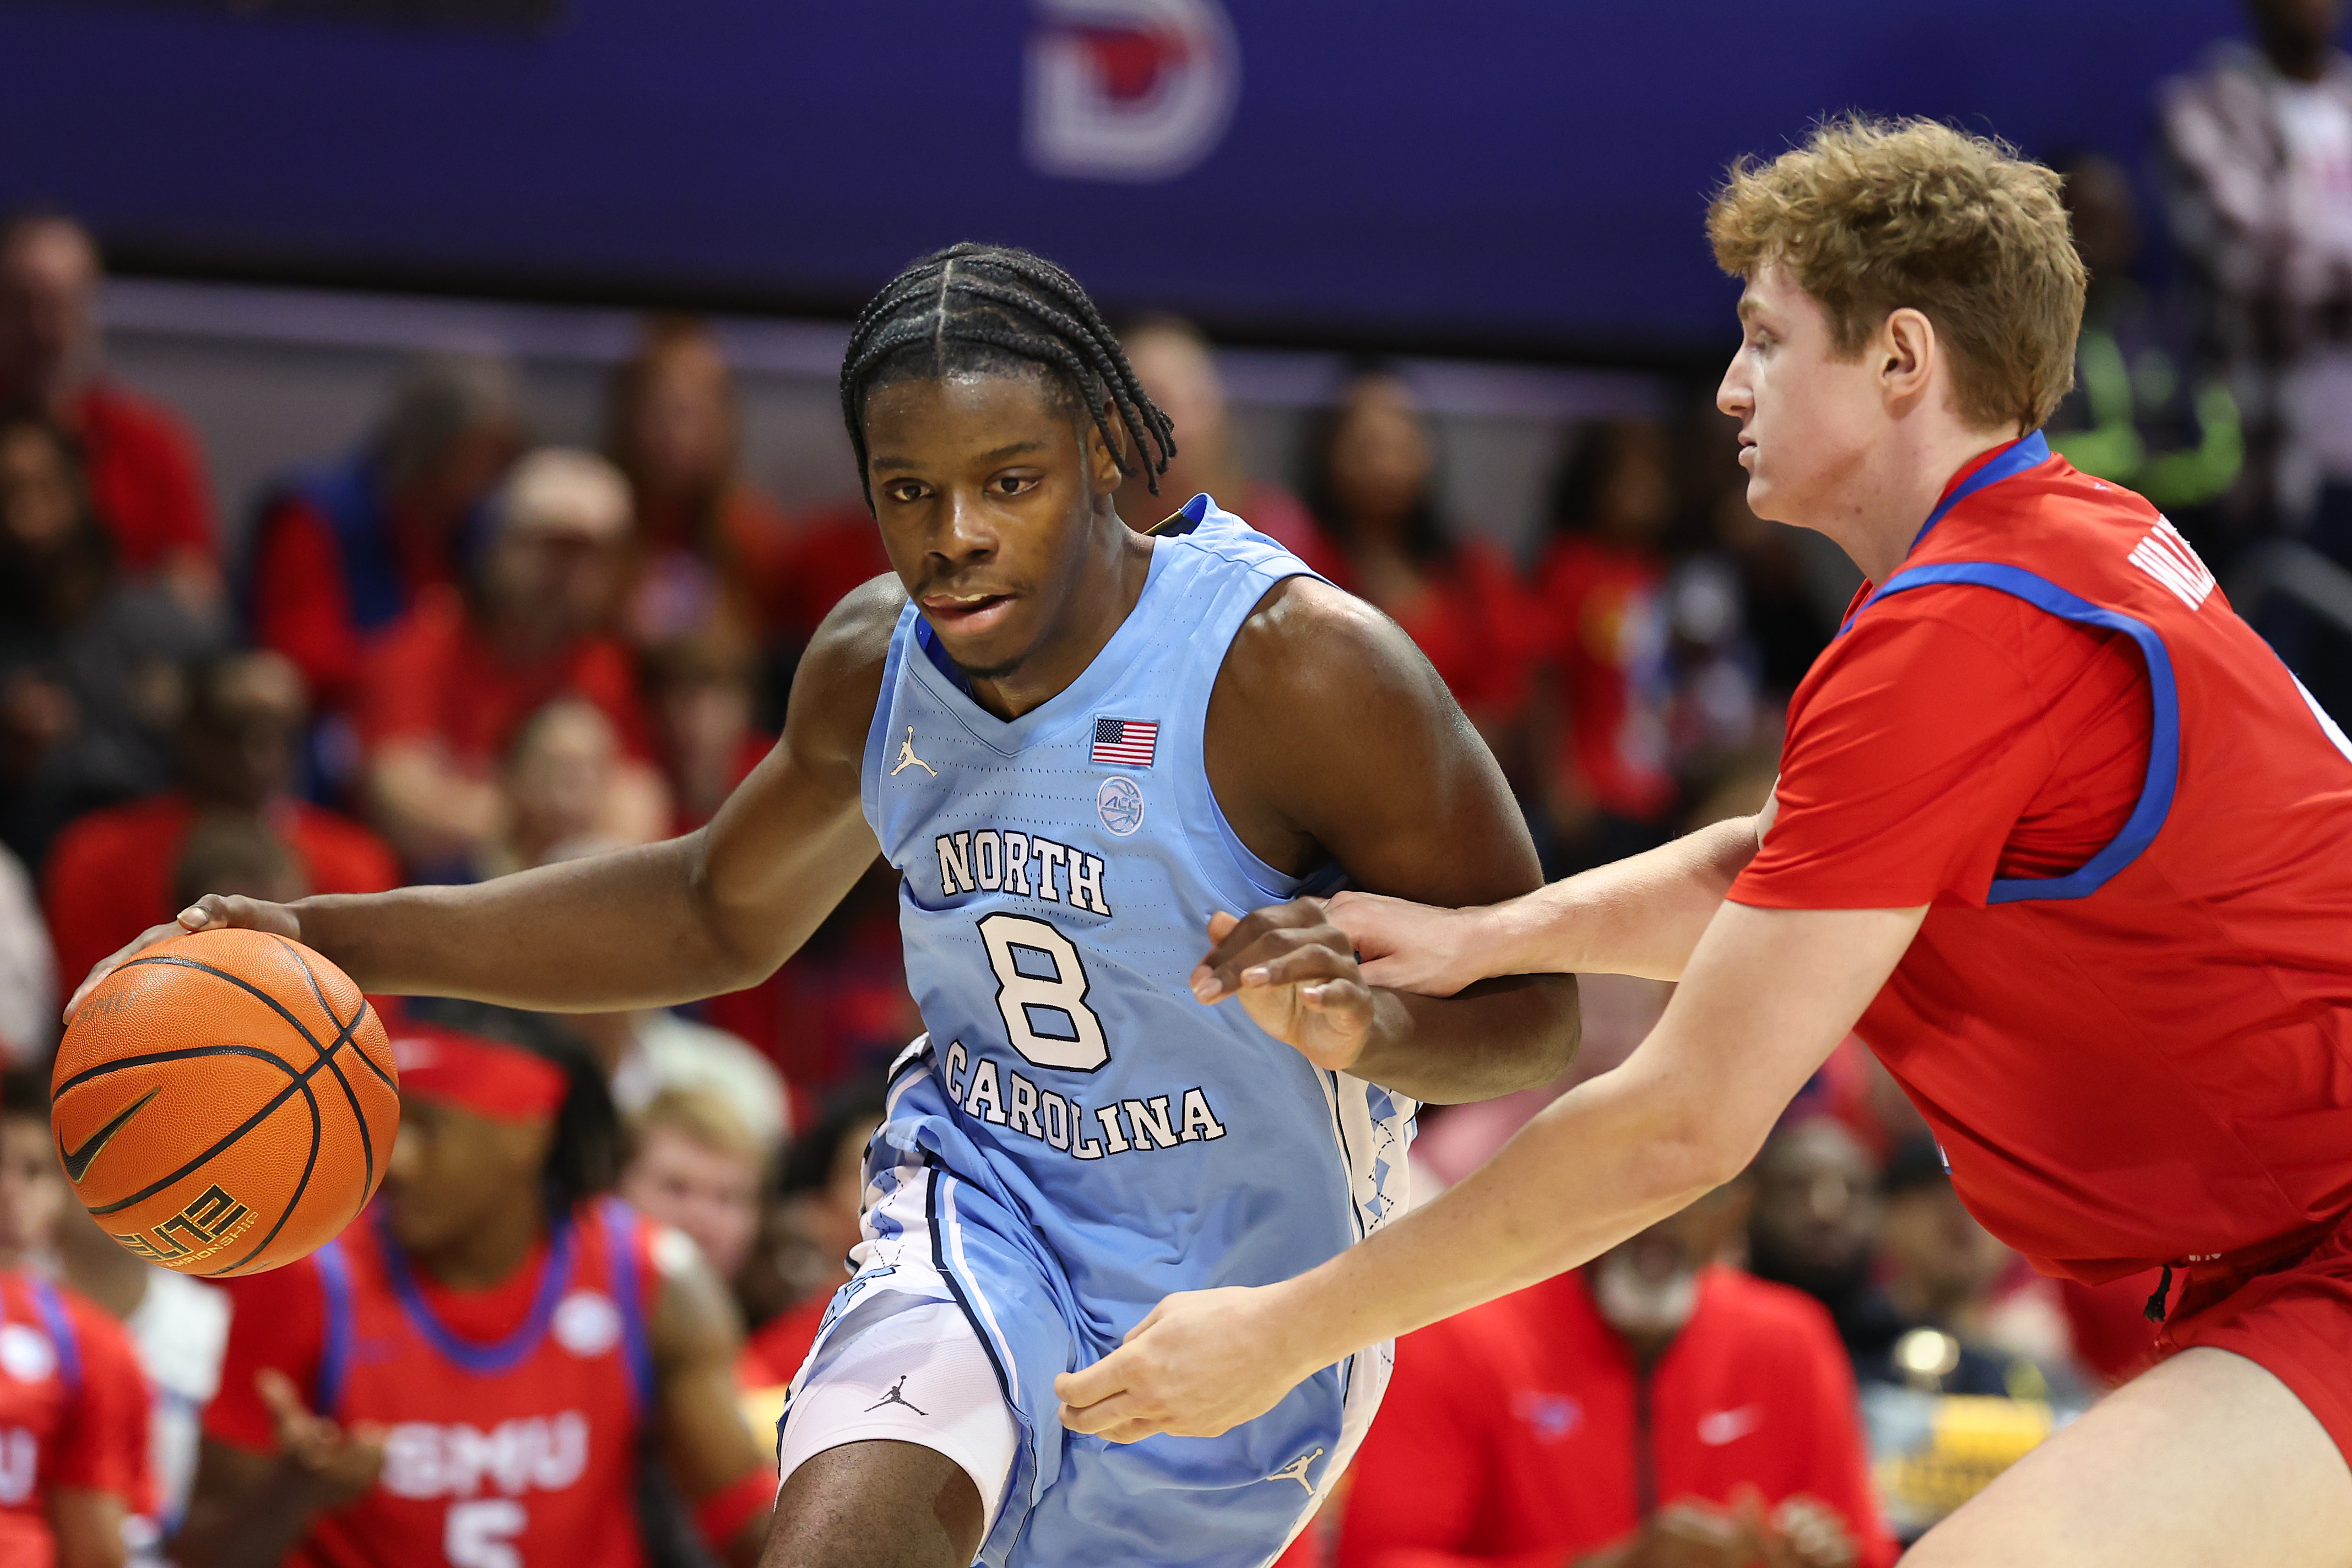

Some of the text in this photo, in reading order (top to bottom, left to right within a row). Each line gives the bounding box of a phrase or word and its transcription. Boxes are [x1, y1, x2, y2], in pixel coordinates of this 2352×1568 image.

[935, 829, 1112, 918] NORTH
[976, 911, 1112, 1073] 8
[944, 1039, 1227, 1160] CAROLINA
[165, 1211, 259, 1268] AMPIONSHIP
[384, 1413, 589, 1499] SMU
[446, 1498, 526, 1568] 5
